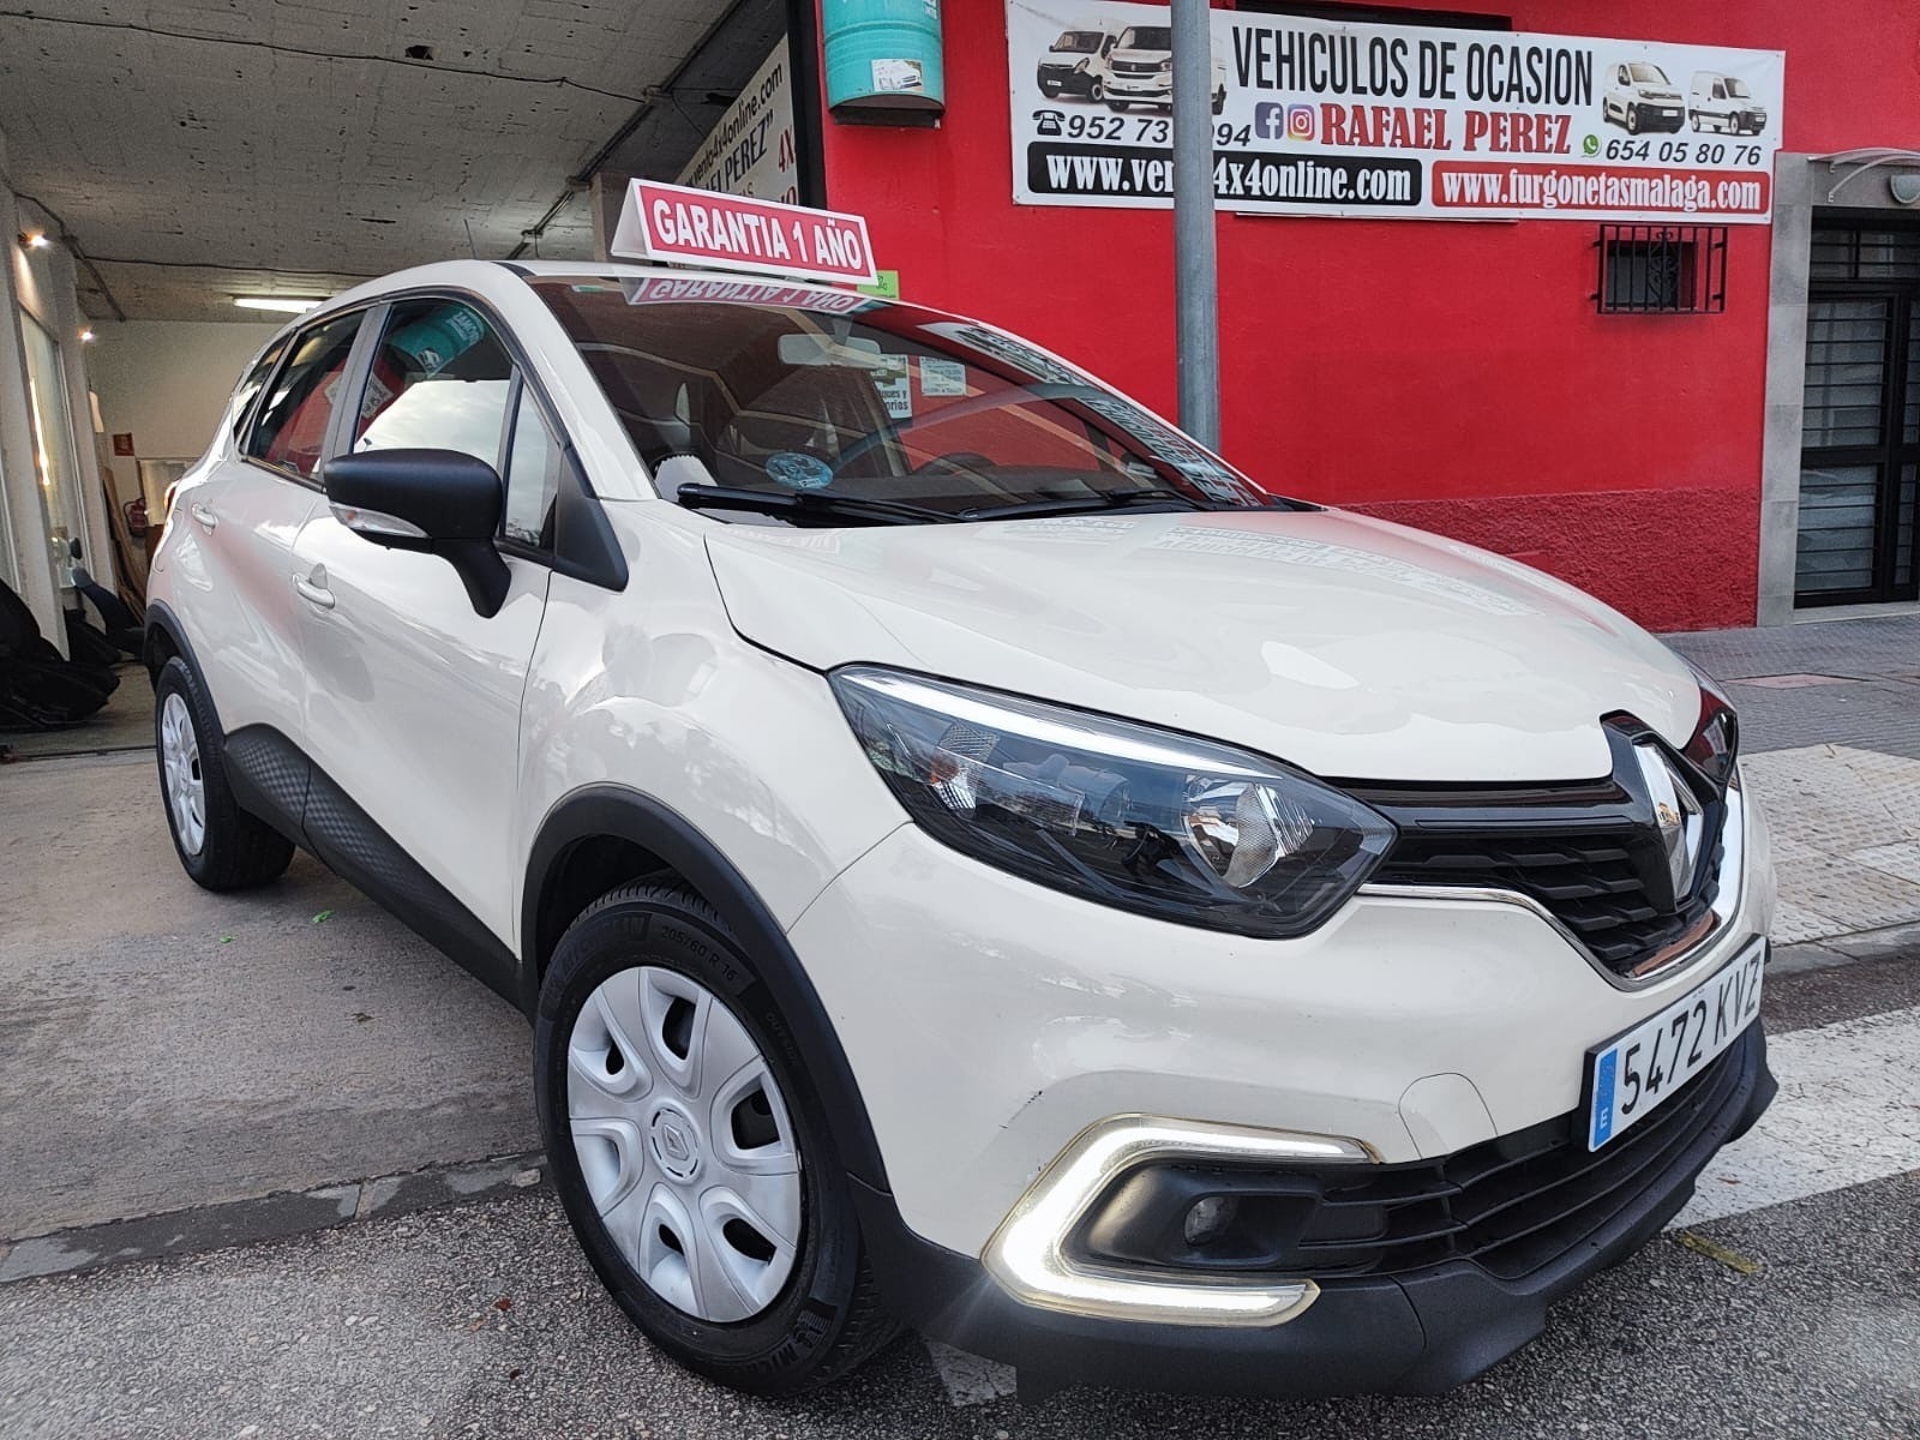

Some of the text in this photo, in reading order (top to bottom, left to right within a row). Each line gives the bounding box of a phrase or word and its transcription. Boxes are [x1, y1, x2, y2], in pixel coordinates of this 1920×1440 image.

[1232, 26, 1593, 106] VEHICULOS DE OCASION
[1067, 114, 1251, 147] 952 73 94
[1320, 102, 1572, 155] RAFAEL PEREZ
[1606, 139, 1762, 166] 654 05 80 76
[1442, 168, 1761, 212] www.furgonetasmalaga.com
[652, 199, 862, 270] GARANTIA 1 AÑO
[661, 925, 708, 958] 205/60
[722, 963, 738, 981] 16
[1621, 950, 1762, 1116] 5472 KVZ
[1600, 1108, 1608, 1129] E
